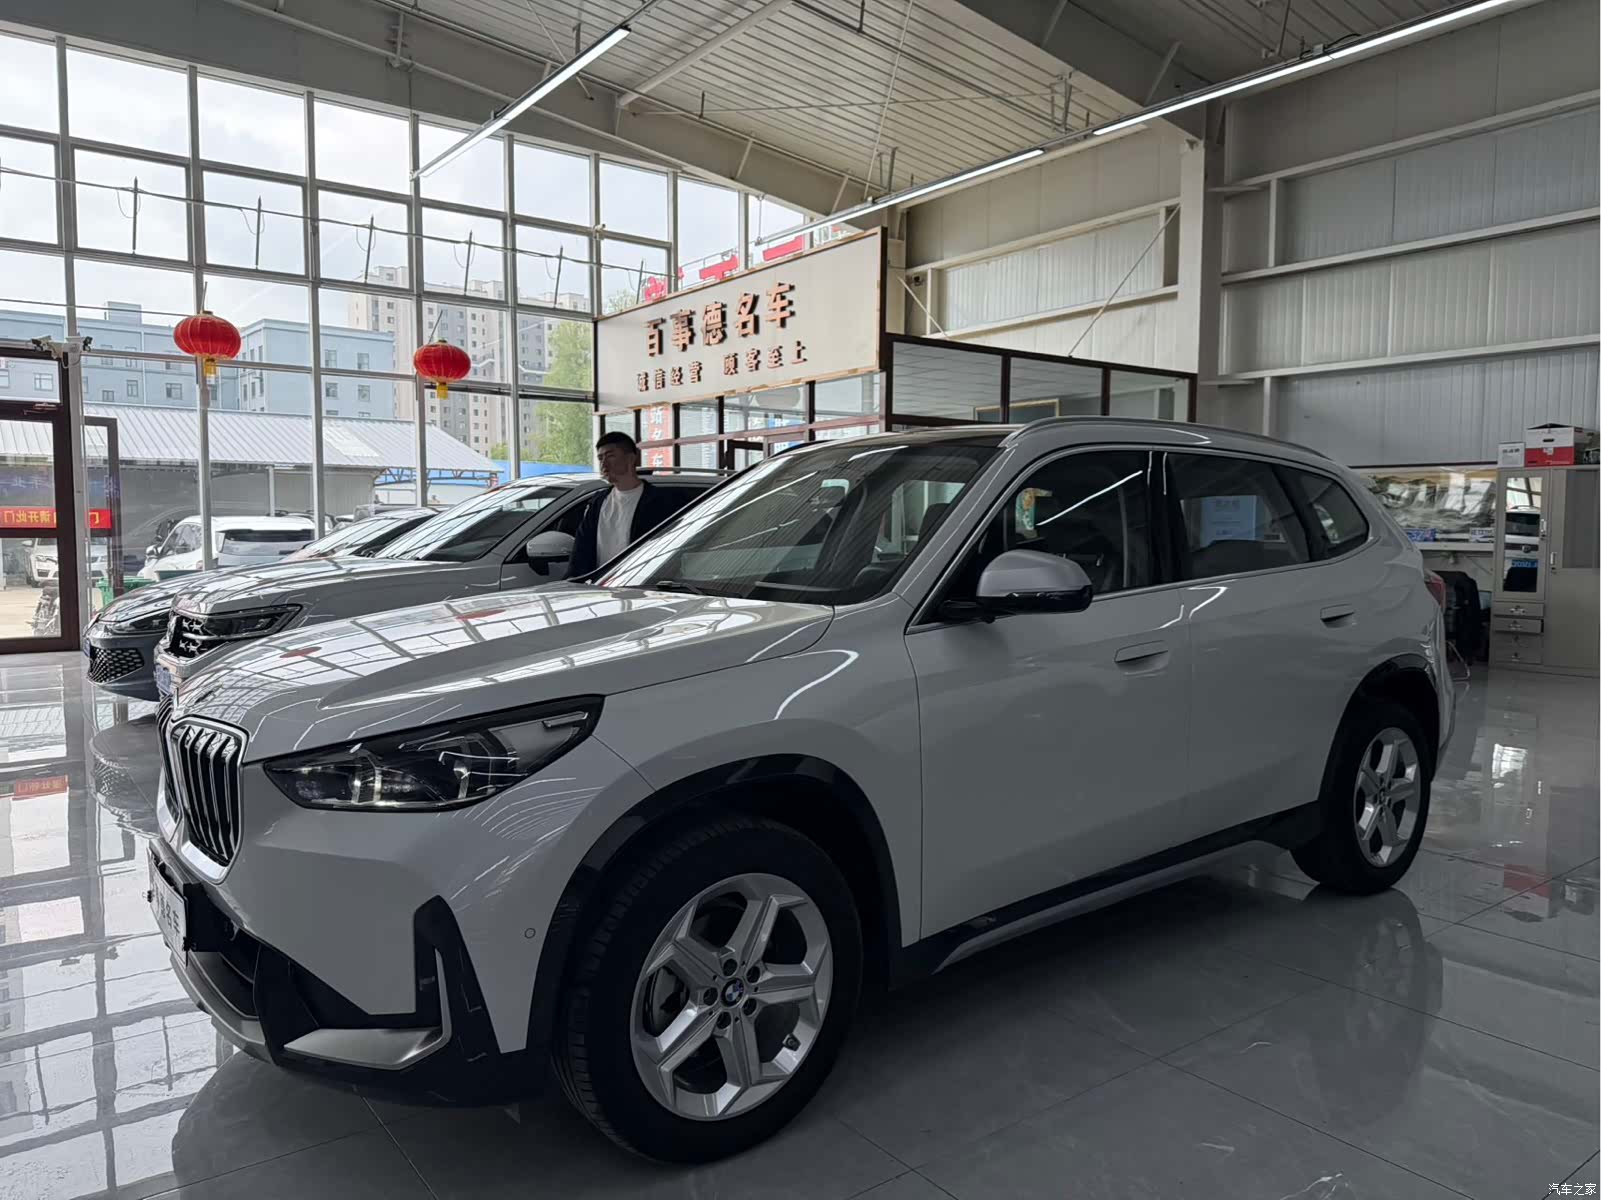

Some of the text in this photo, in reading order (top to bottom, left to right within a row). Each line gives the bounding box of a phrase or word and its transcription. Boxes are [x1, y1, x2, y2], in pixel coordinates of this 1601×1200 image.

[644, 282, 796, 357] 百事德名车
[637, 341, 808, 392] 诚信经营 顾客至上
